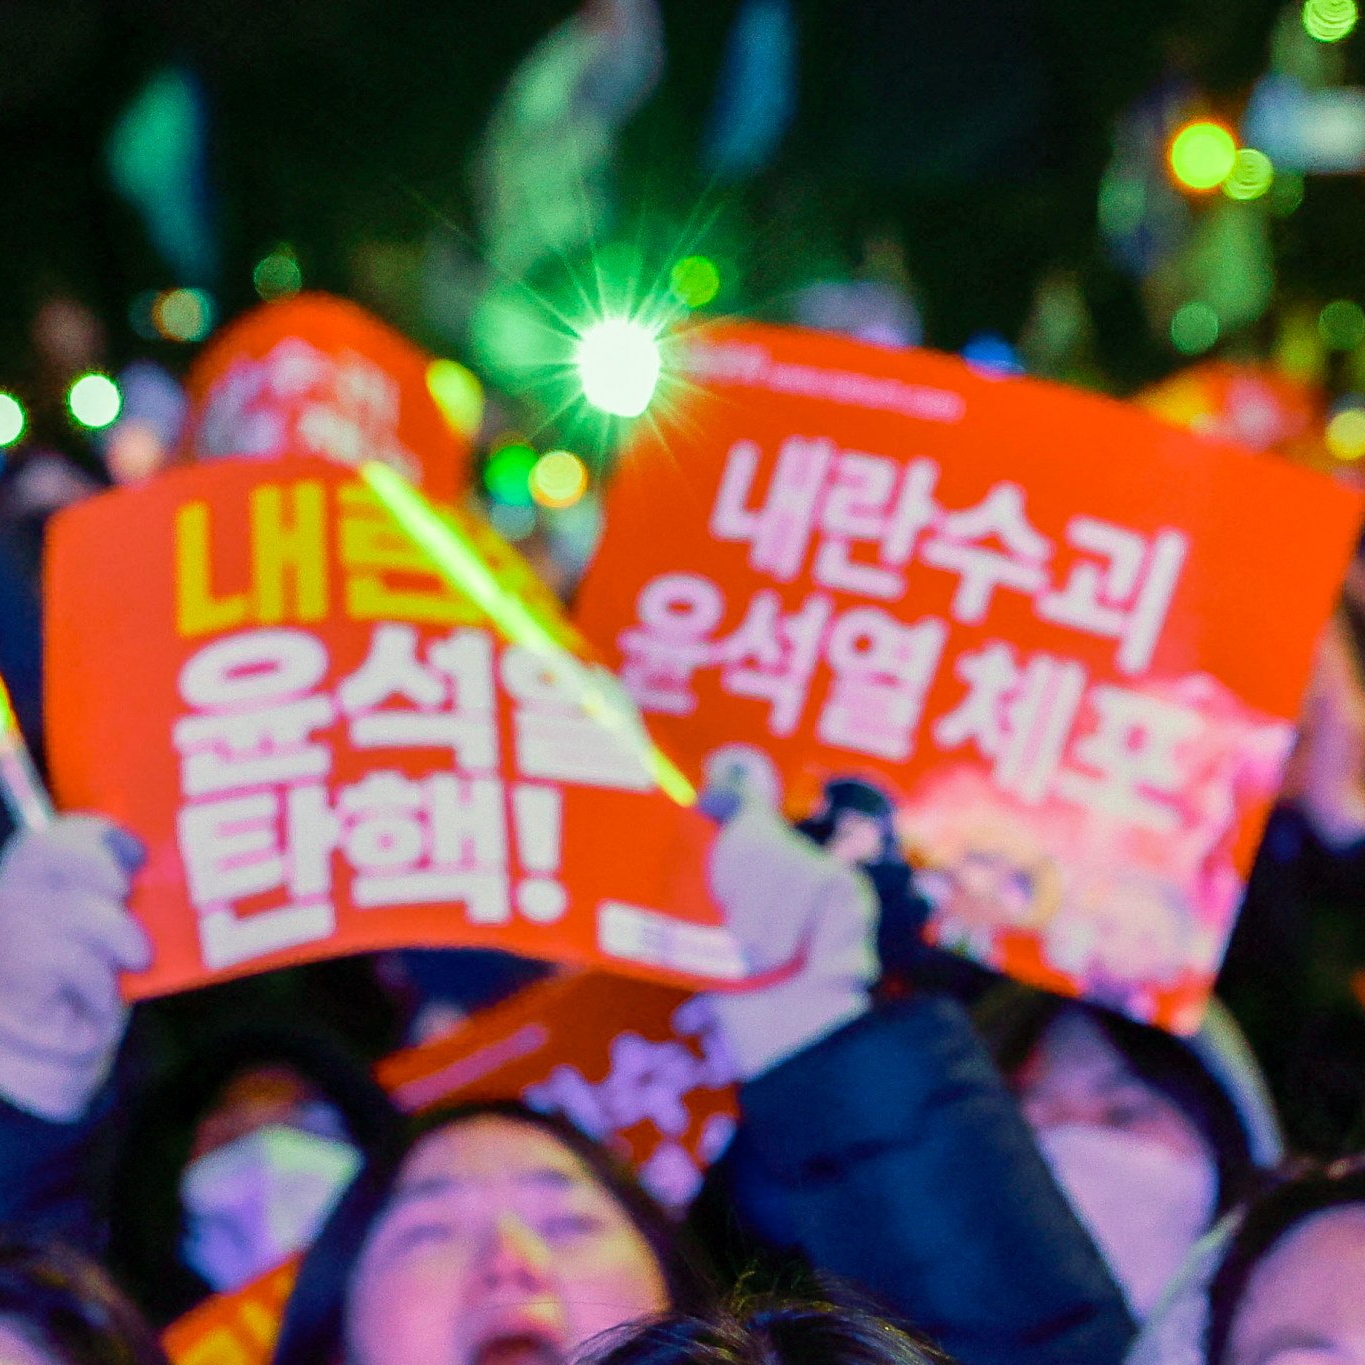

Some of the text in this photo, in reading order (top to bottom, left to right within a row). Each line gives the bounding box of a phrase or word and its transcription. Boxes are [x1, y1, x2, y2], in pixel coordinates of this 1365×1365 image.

[709, 434, 1190, 677] 내란수괴
[618, 572, 1205, 832] 윤석열 체포
[175, 768, 569, 971] 탄핵!
